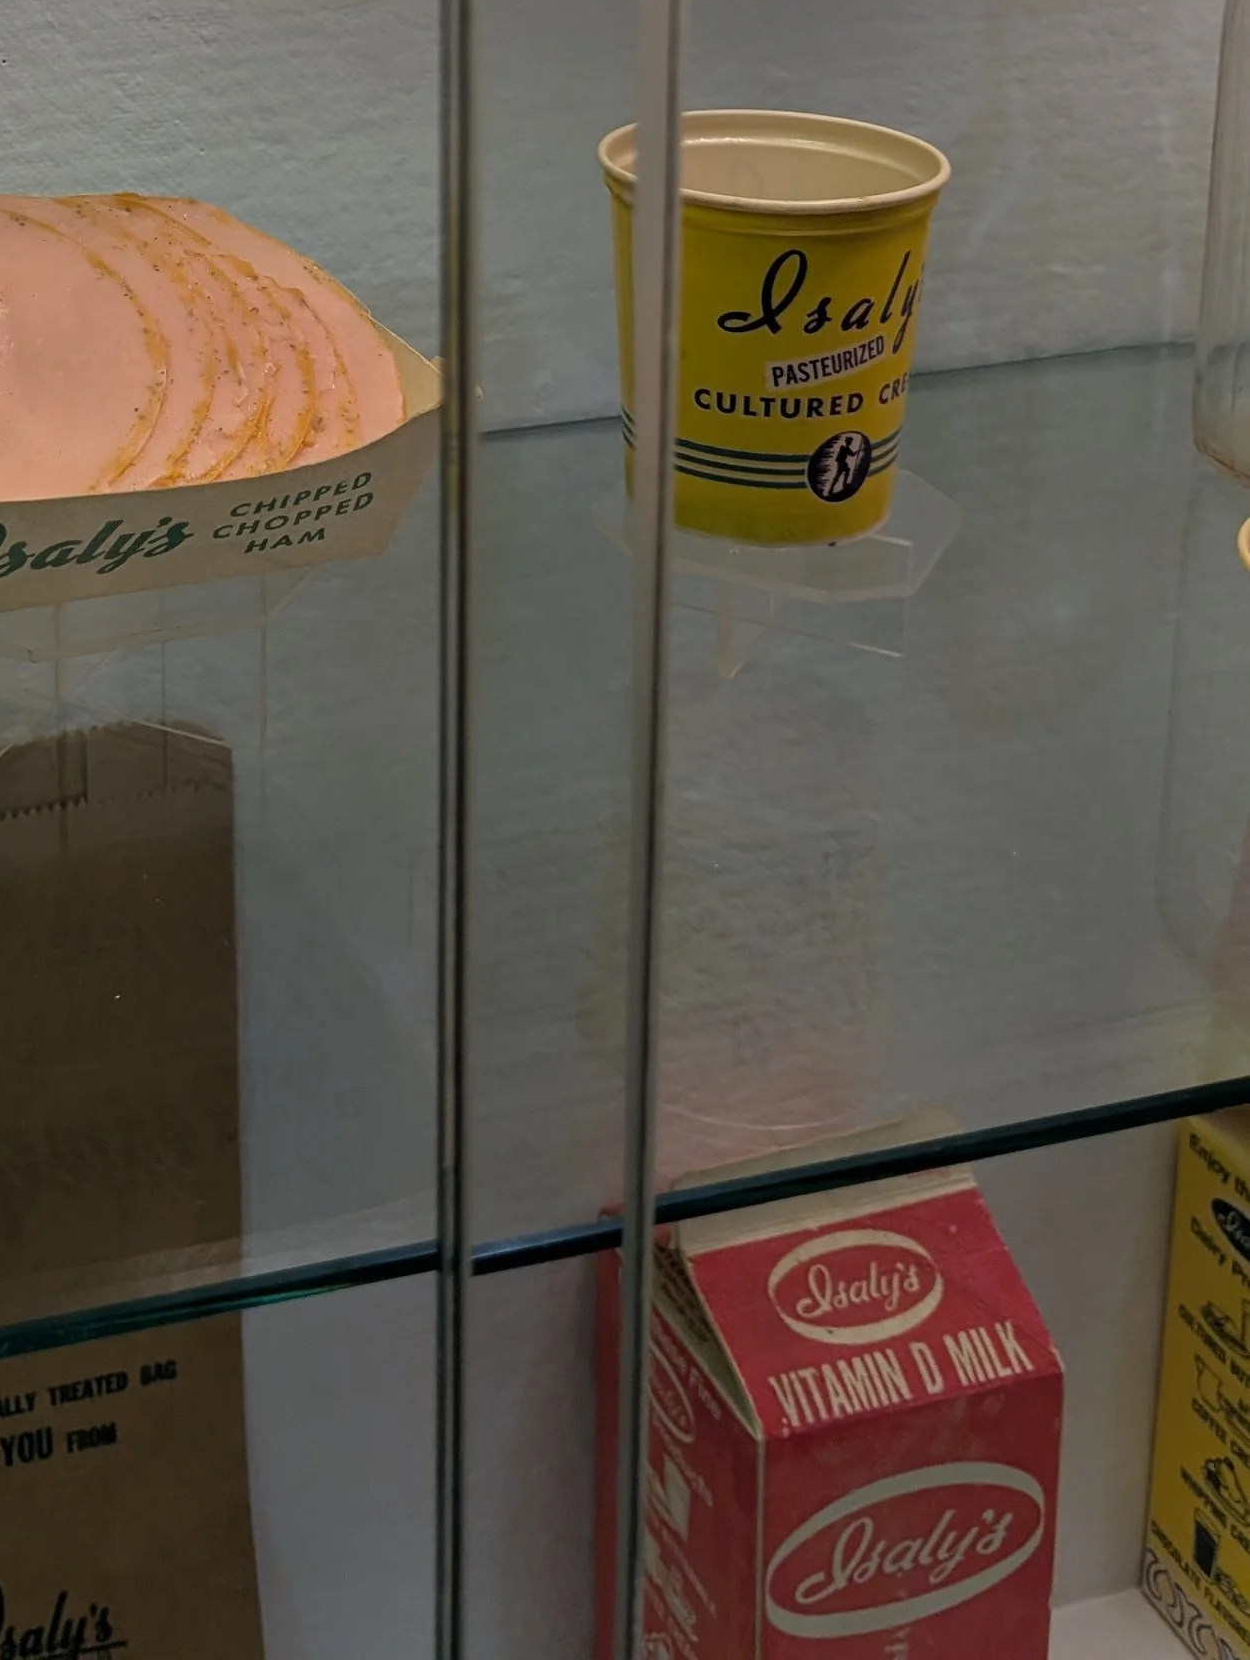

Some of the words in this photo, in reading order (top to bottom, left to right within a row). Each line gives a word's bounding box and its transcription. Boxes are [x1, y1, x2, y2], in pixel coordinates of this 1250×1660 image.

[772, 336, 885, 387] PASTEURIZED
[693, 388, 864, 419] CULTURED
[213, 492, 374, 540] CHOPPED
[230, 472, 372, 517] CHIPPED
[244, 528, 326, 554] HAM
[796, 1263, 920, 1318] Isaly's
[48, 1372, 128, 1406] TREATED
[140, 1360, 176, 1384] BAG
[768, 1346, 912, 1429] VITAMIN
[911, 1341, 944, 1394] D
[943, 1319, 1034, 1389] MILK
[0, 1429, 52, 1467] YOU
[67, 1422, 117, 1452] FROM
[794, 1508, 1014, 1606] Isaly's
